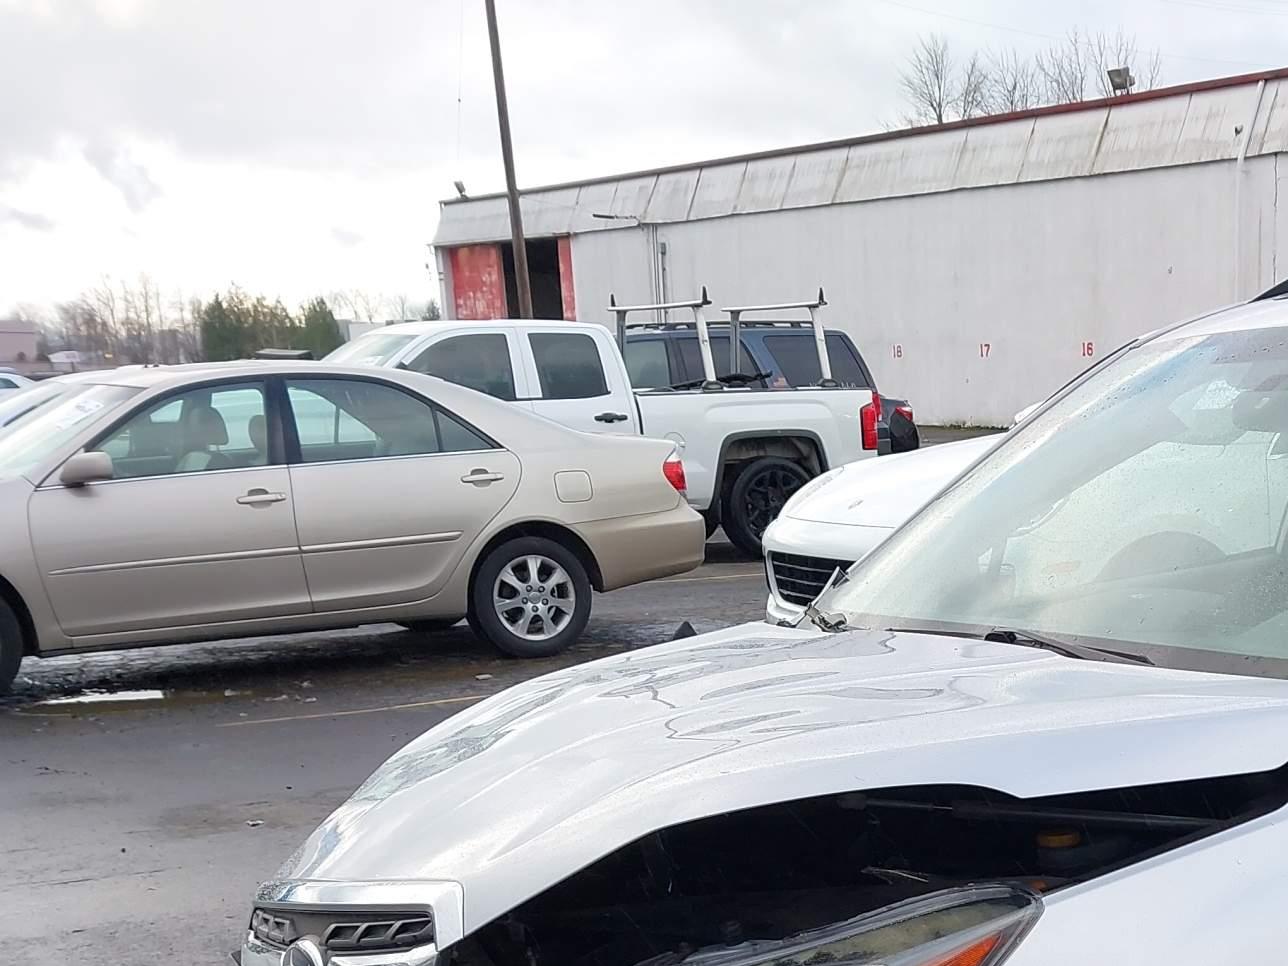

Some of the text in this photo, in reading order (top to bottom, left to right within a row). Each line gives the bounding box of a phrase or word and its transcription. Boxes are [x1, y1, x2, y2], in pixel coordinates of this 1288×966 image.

[892, 344, 903, 359] 18
[979, 343, 991, 358] 17
[1081, 342, 1094, 357] 16
